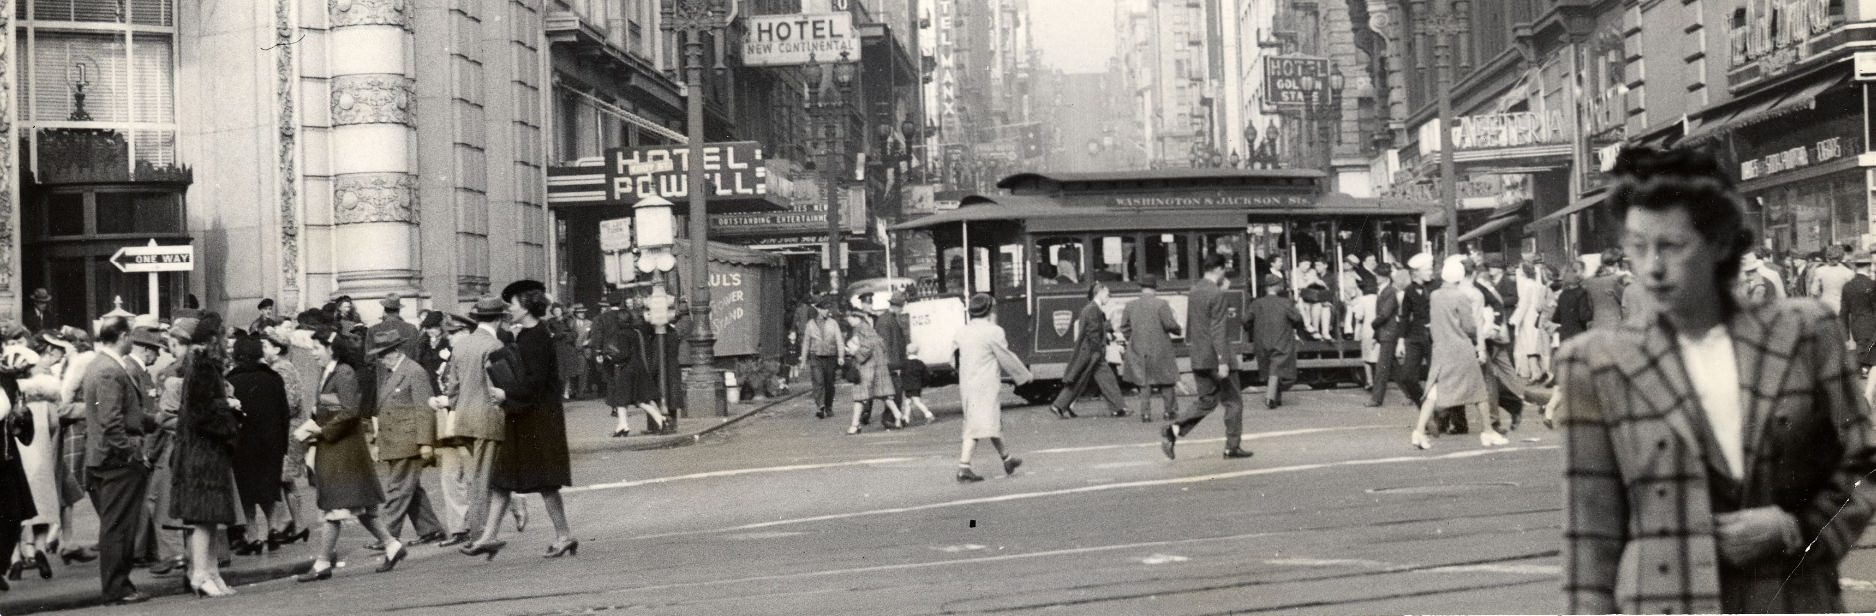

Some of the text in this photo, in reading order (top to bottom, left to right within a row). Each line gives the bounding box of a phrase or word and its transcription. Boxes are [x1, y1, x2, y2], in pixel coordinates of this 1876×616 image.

[757, 19, 844, 42] HOTEL
[747, 40, 854, 54] NEW CONTINENTAL
[940, 1, 955, 114] TEL MANX
[76, 63, 89, 85] 1
[1271, 59, 1327, 76] HOTEL
[1276, 78, 1322, 90] GOLN
[1281, 90, 1319, 101] STAE
[617, 147, 748, 174] HOTEL
[614, 172, 753, 200] POWLL
[1116, 197, 1200, 206] WASHINGTON
[1204, 198, 1214, 206] &
[1217, 197, 1282, 206] JACKSON
[718, 214, 828, 226] OUTSTANDING ENTERTAINME
[135, 253, 189, 264] ONE WAY
[708, 272, 742, 287] UL'S
